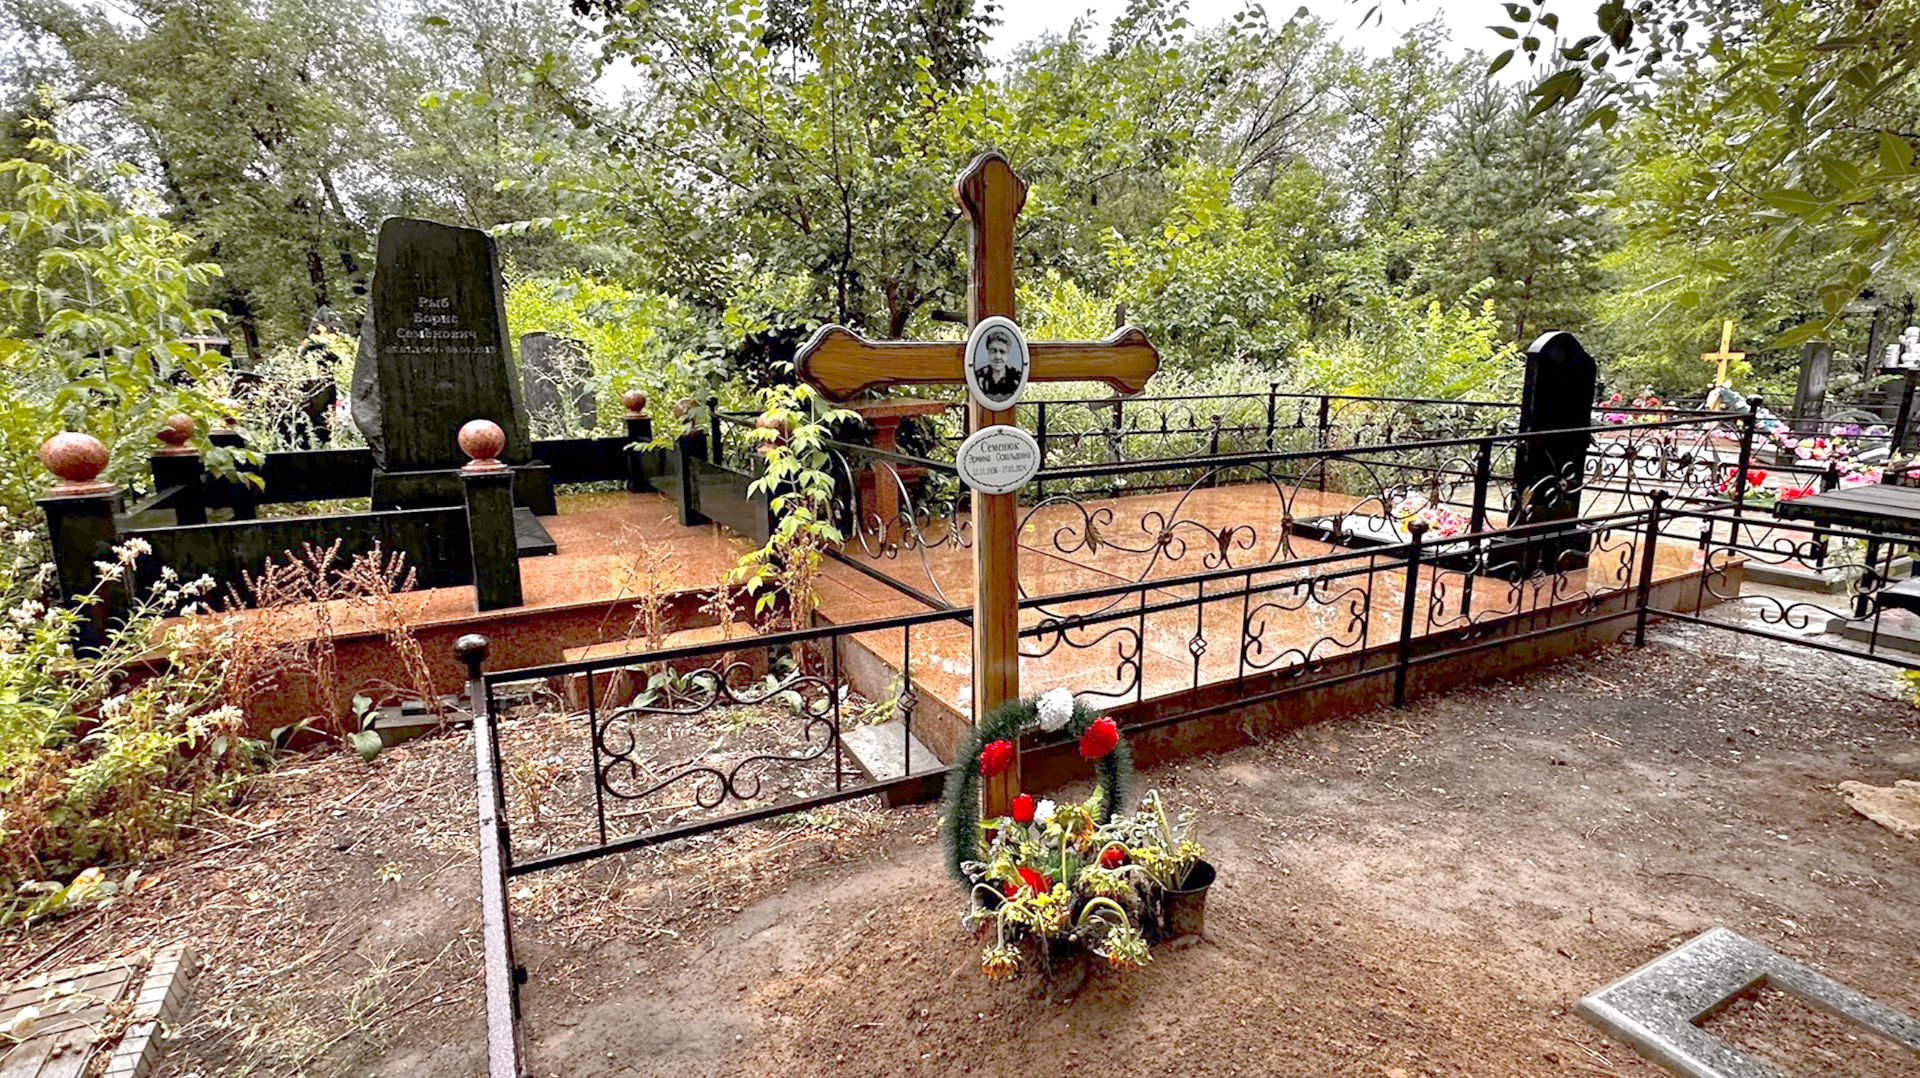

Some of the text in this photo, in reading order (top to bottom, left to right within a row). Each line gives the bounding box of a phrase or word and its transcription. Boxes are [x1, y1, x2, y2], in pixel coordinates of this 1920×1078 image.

[418, 296, 450, 308] Рыб
[413, 312, 459, 326] Борис
[980, 441, 1020, 453] Семенюк
